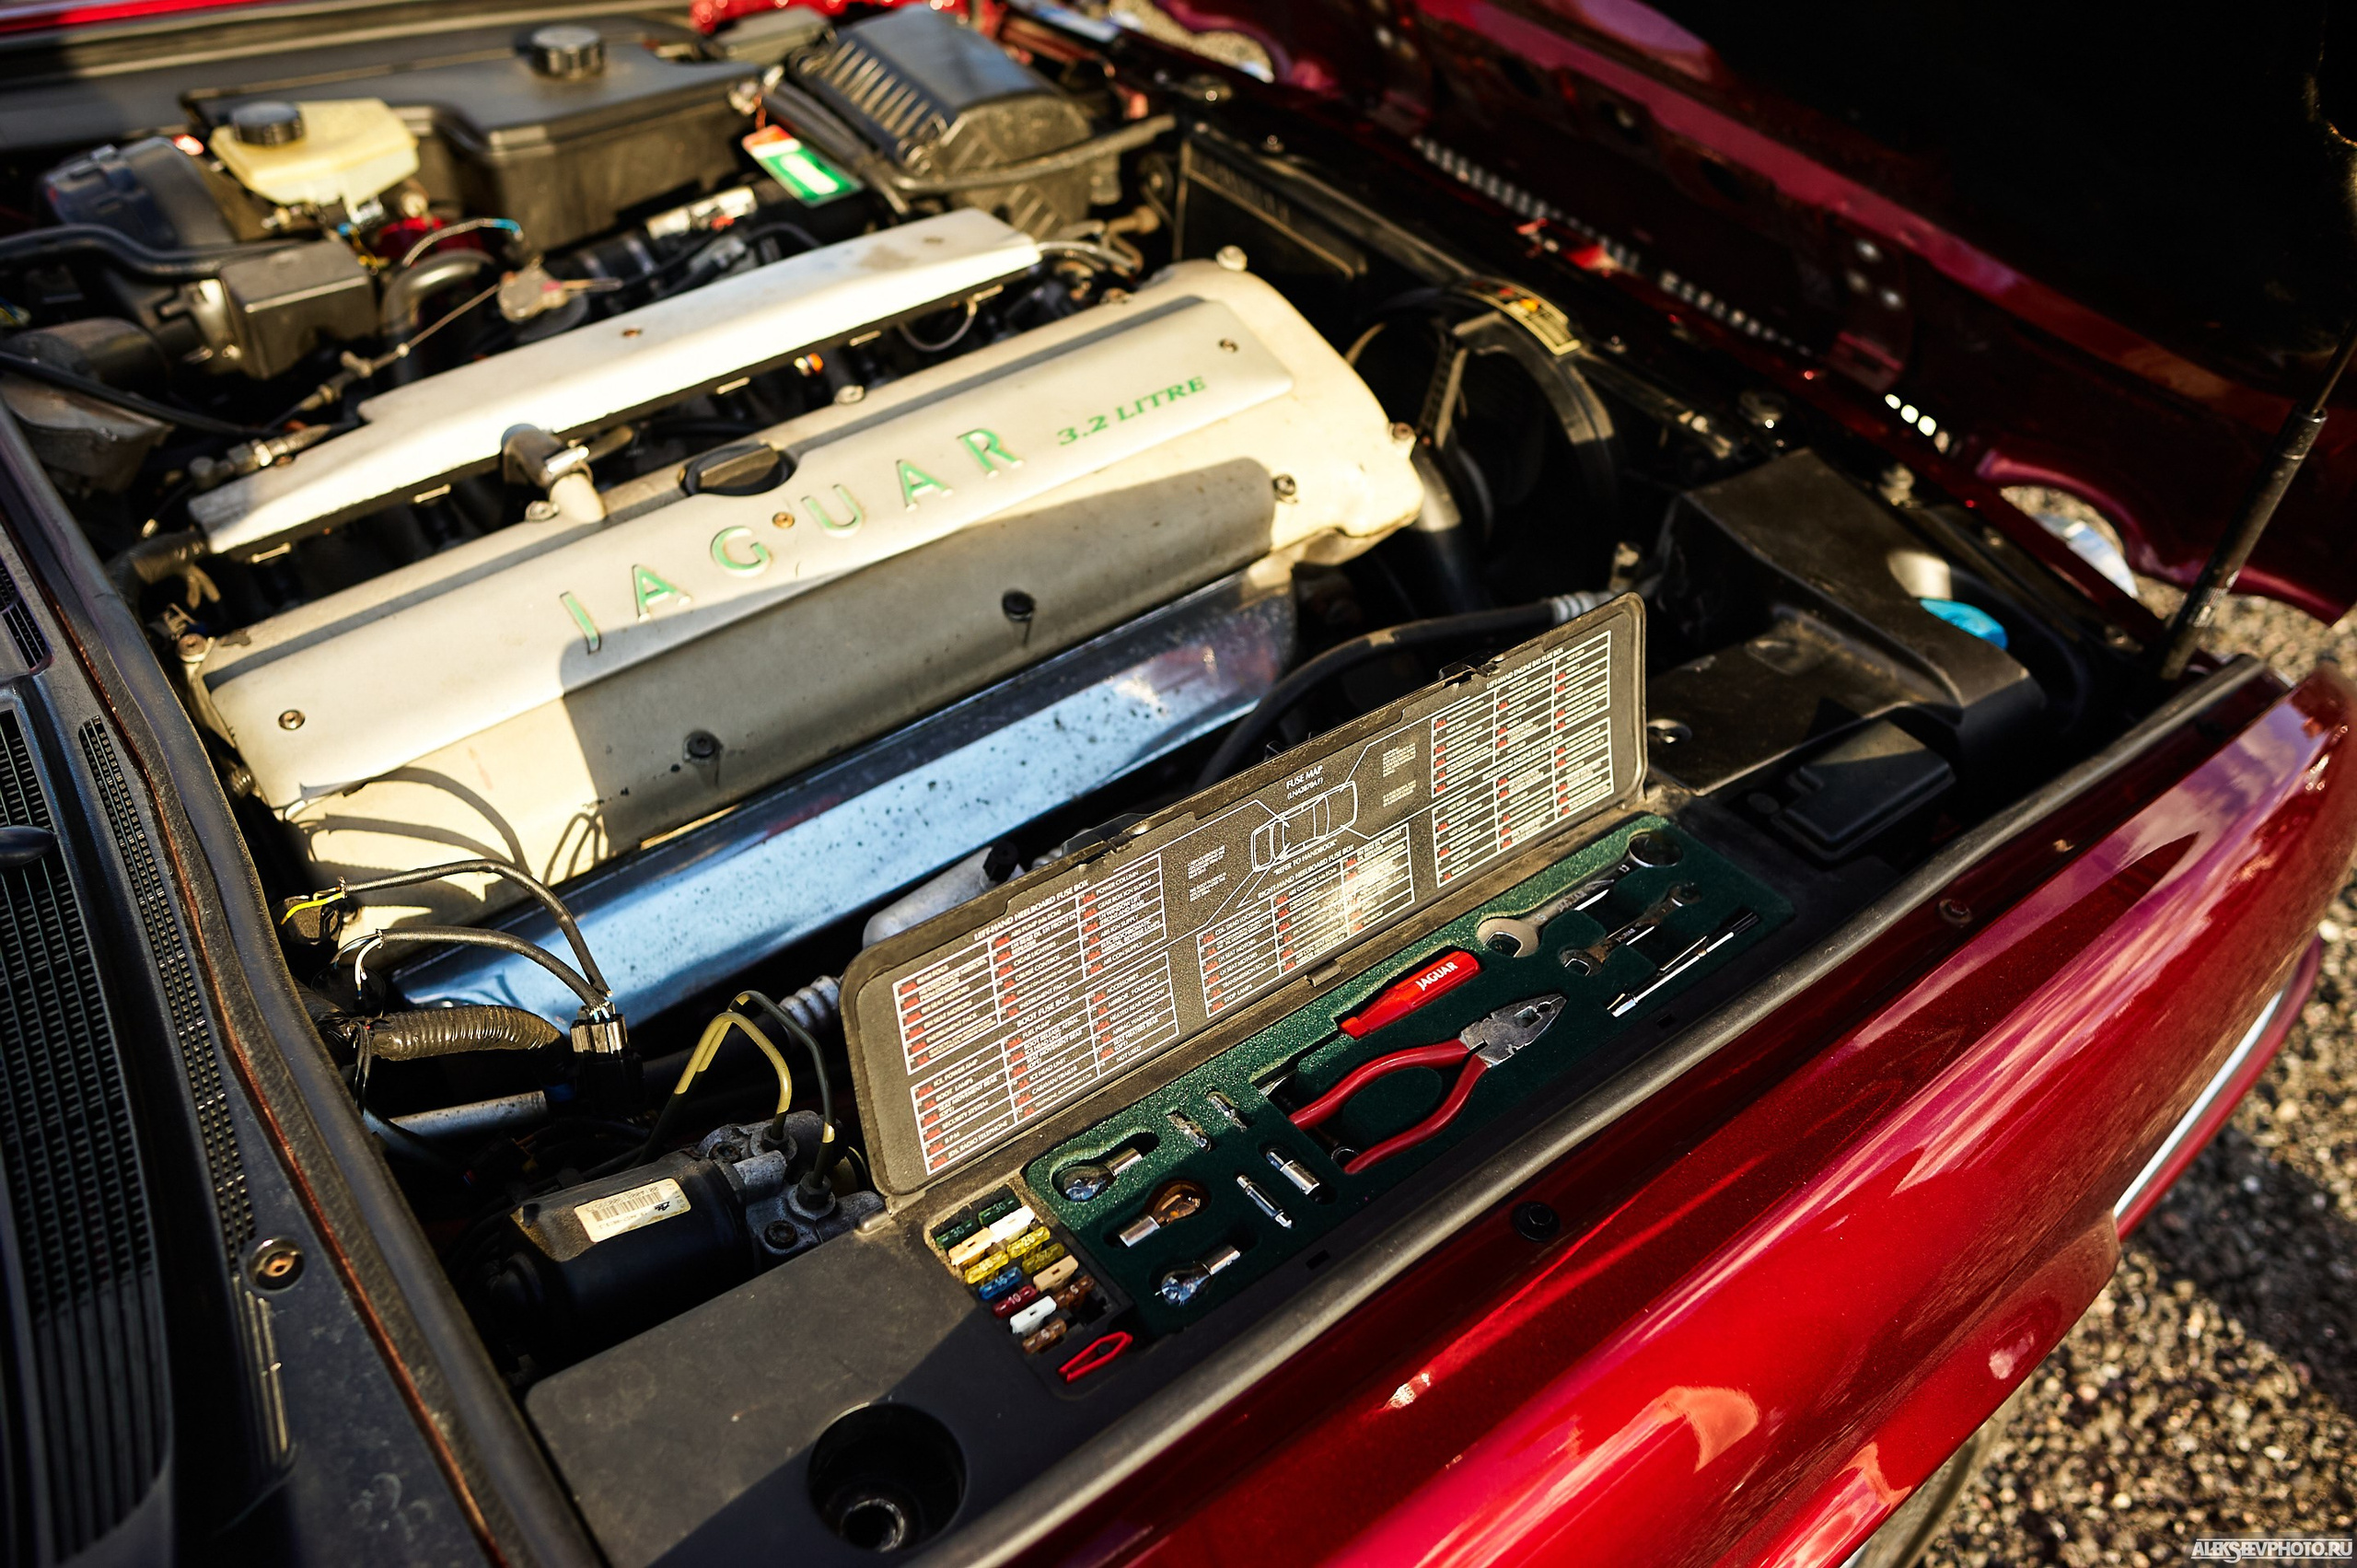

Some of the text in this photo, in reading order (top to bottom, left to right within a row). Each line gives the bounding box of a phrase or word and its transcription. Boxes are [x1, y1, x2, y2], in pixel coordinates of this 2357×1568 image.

[1058, 376, 1206, 447] 3.2 LITRE
[560, 426, 1027, 655] JAGUAR
[1415, 961, 1458, 992] JAGUAR
[993, 1202, 1006, 1214] 30
[951, 1226, 965, 1237] 30
[1008, 1293, 1021, 1305] 10
